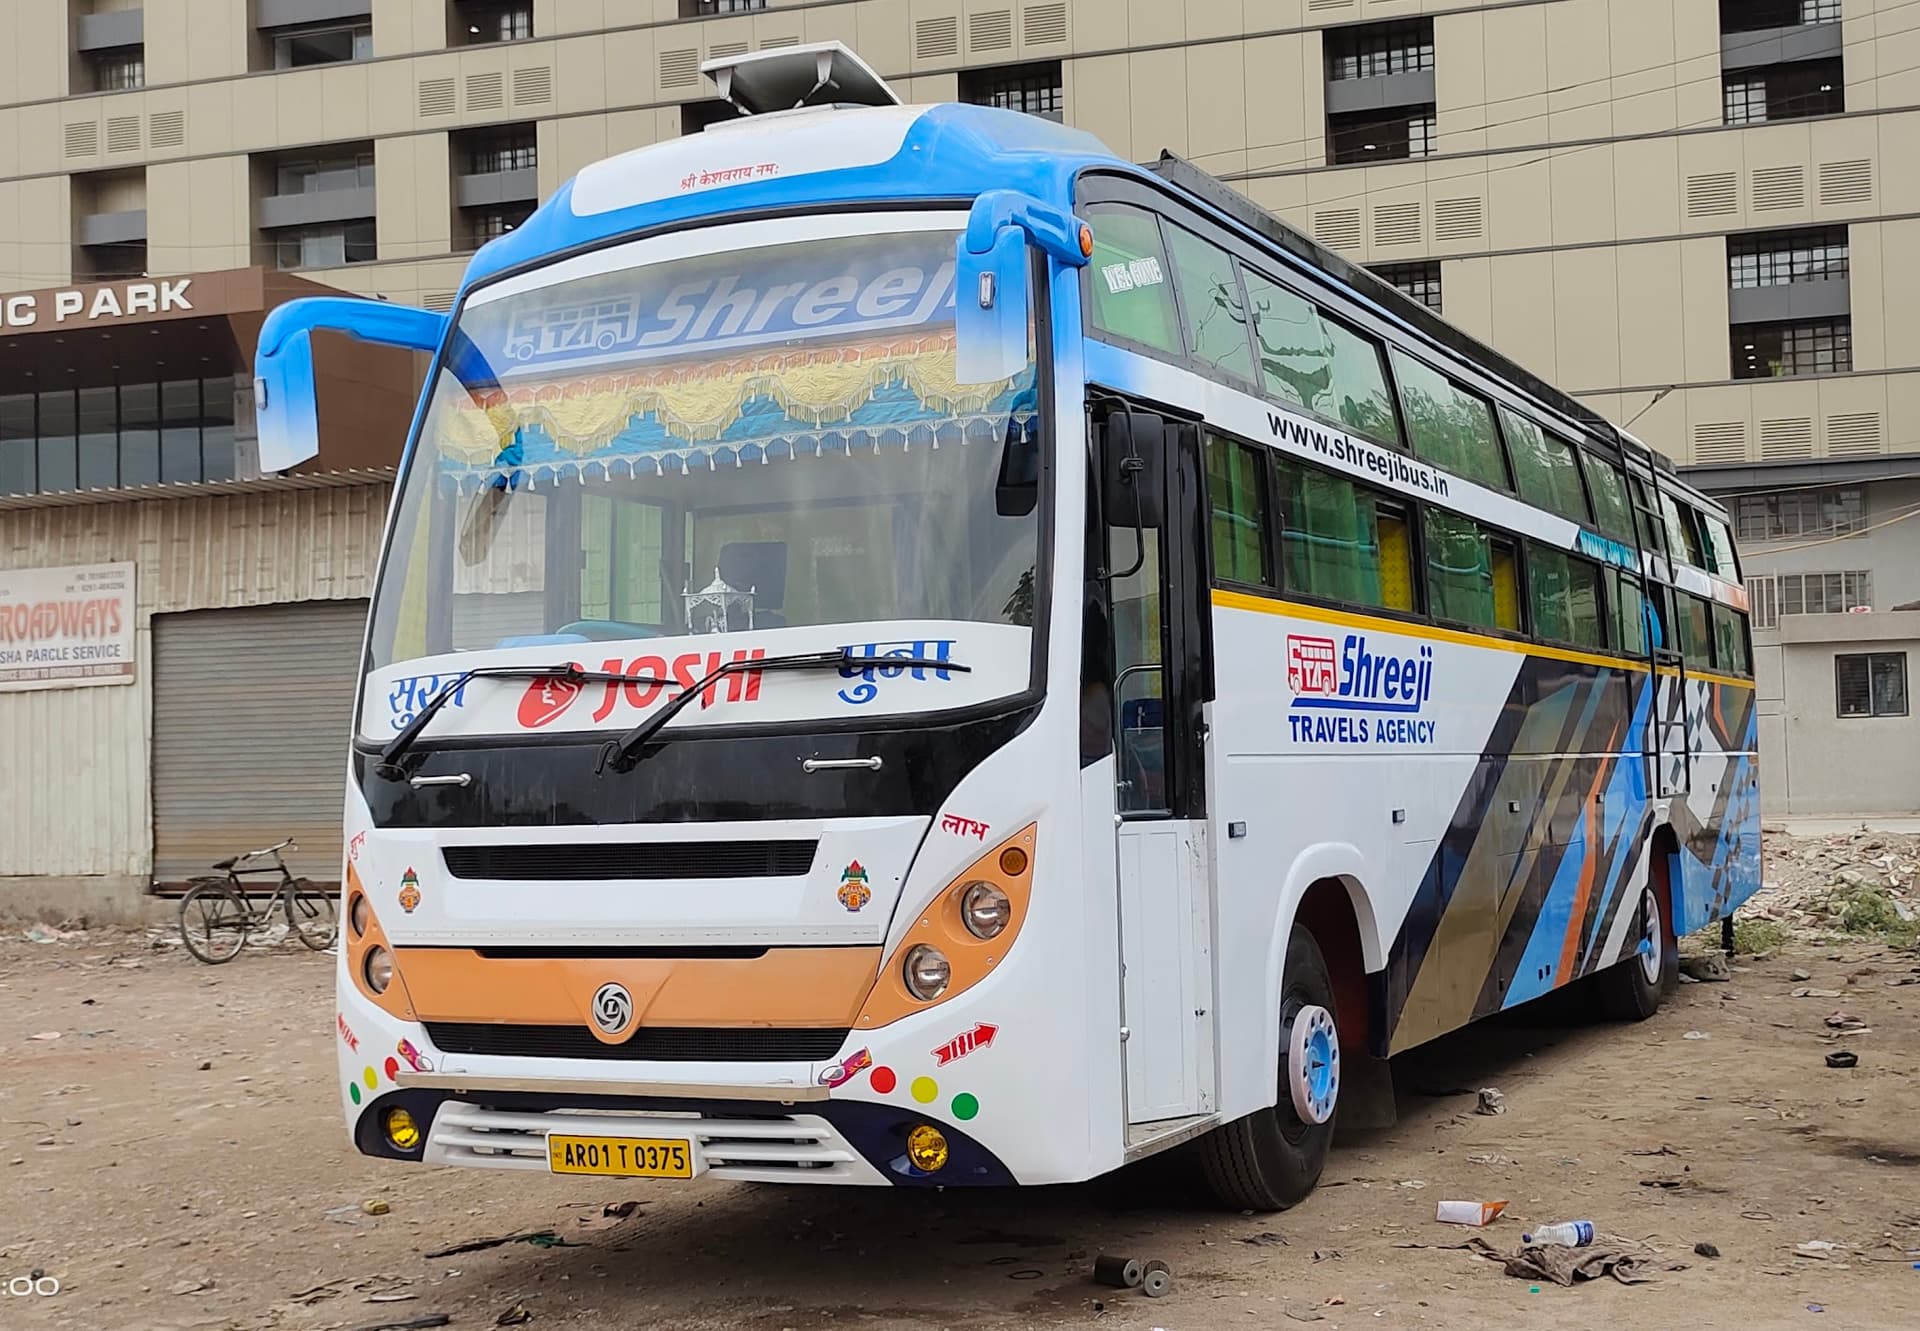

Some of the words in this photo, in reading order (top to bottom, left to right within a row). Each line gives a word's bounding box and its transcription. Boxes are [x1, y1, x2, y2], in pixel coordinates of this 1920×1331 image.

[0, 295, 38, 328] C
[55, 279, 194, 323] PARK
[636, 256, 957, 346] Shreej
[1266, 412, 1449, 498] www.shreejibus.in
[0, 598, 122, 645] ROADWAYS
[26, 647, 69, 662] PARCLE
[72, 643, 121, 661] SERVICE
[1338, 635, 1433, 712] Shreeji
[591, 648, 766, 724] JOSHI
[1288, 715, 1369, 743] TRAVELS
[1375, 719, 1435, 744] AGENCY
[941, 812, 990, 842] लाभ
[565, 1143, 610, 1168] AR01
[618, 1145, 628, 1169] T
[634, 1146, 685, 1170] 0375
